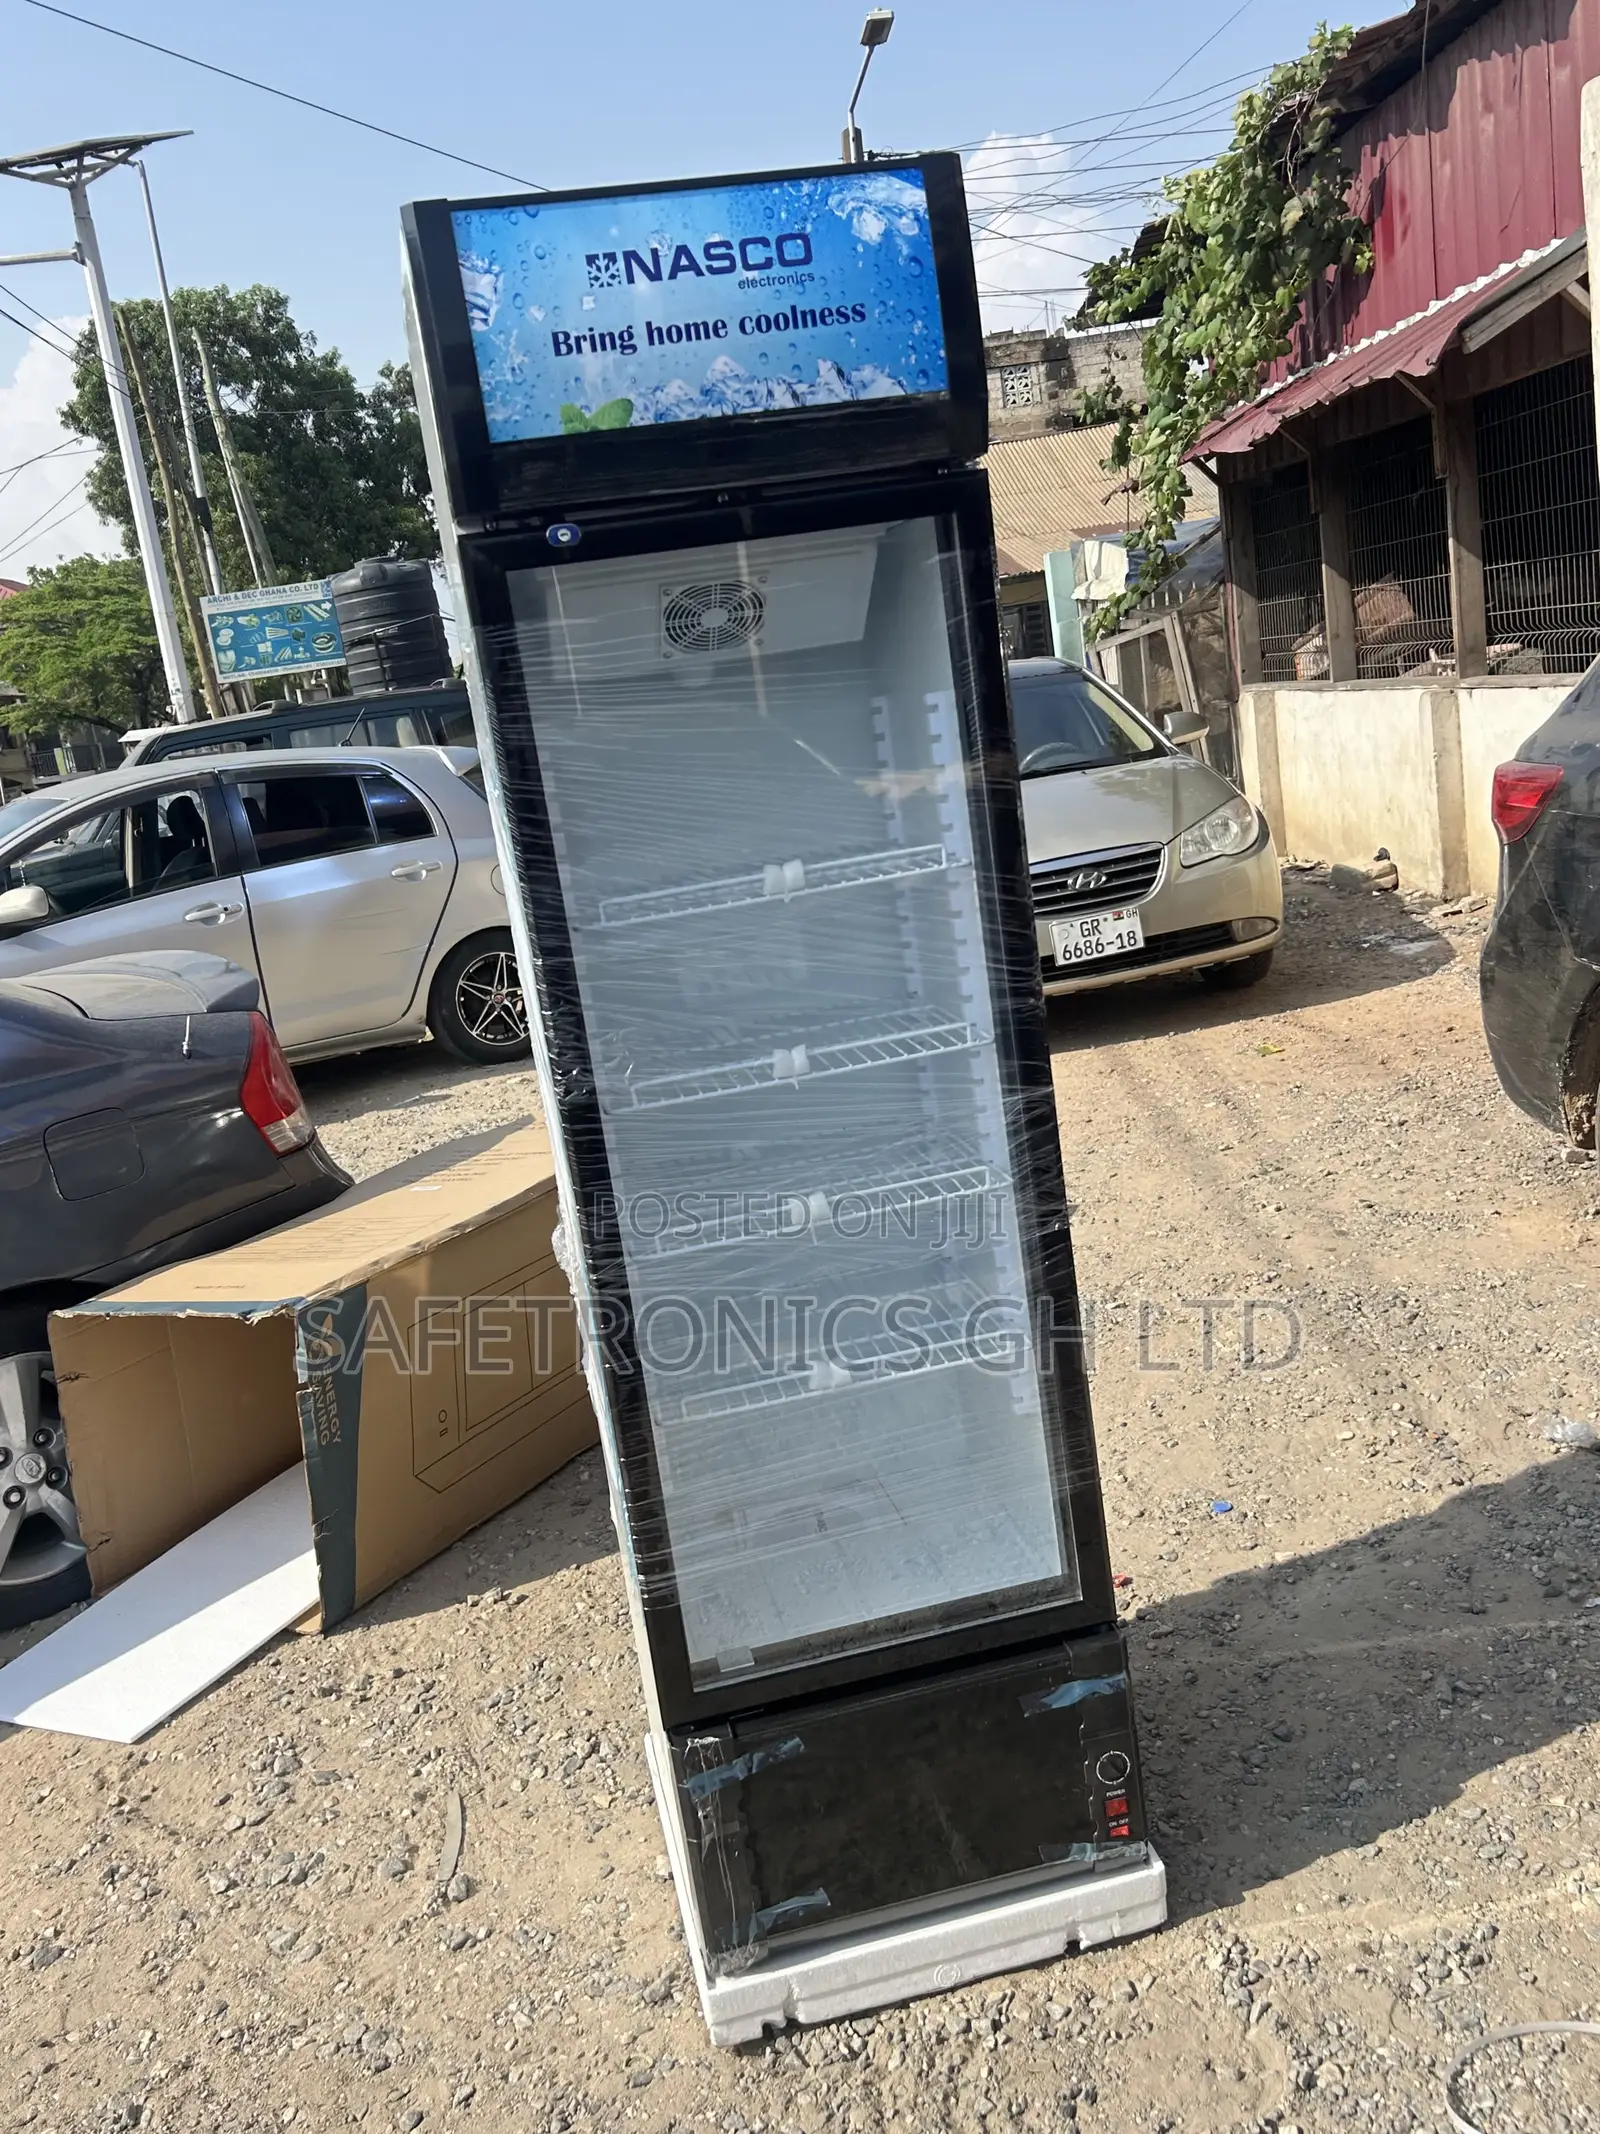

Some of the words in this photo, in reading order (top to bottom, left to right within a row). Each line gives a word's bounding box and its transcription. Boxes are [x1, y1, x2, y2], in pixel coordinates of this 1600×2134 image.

[622, 233, 813, 284] NASCO
[738, 272, 815, 289] electronics
[552, 325, 638, 357] Bring
[645, 318, 728, 346] home
[739, 303, 866, 336] coolness
[207, 594, 232, 604] ARCHI
[242, 590, 258, 599] DEC
[259, 588, 288, 597] GHANA
[304, 583, 319, 591] LTD
[1126, 909, 1138, 918] GH
[1080, 918, 1102, 938] GR
[1062, 930, 1137, 961] 6686-18
[311, 1371, 330, 1446] SAVING
[324, 1362, 342, 1443] ENERGY
[1106, 1789, 1125, 1797] POWER
